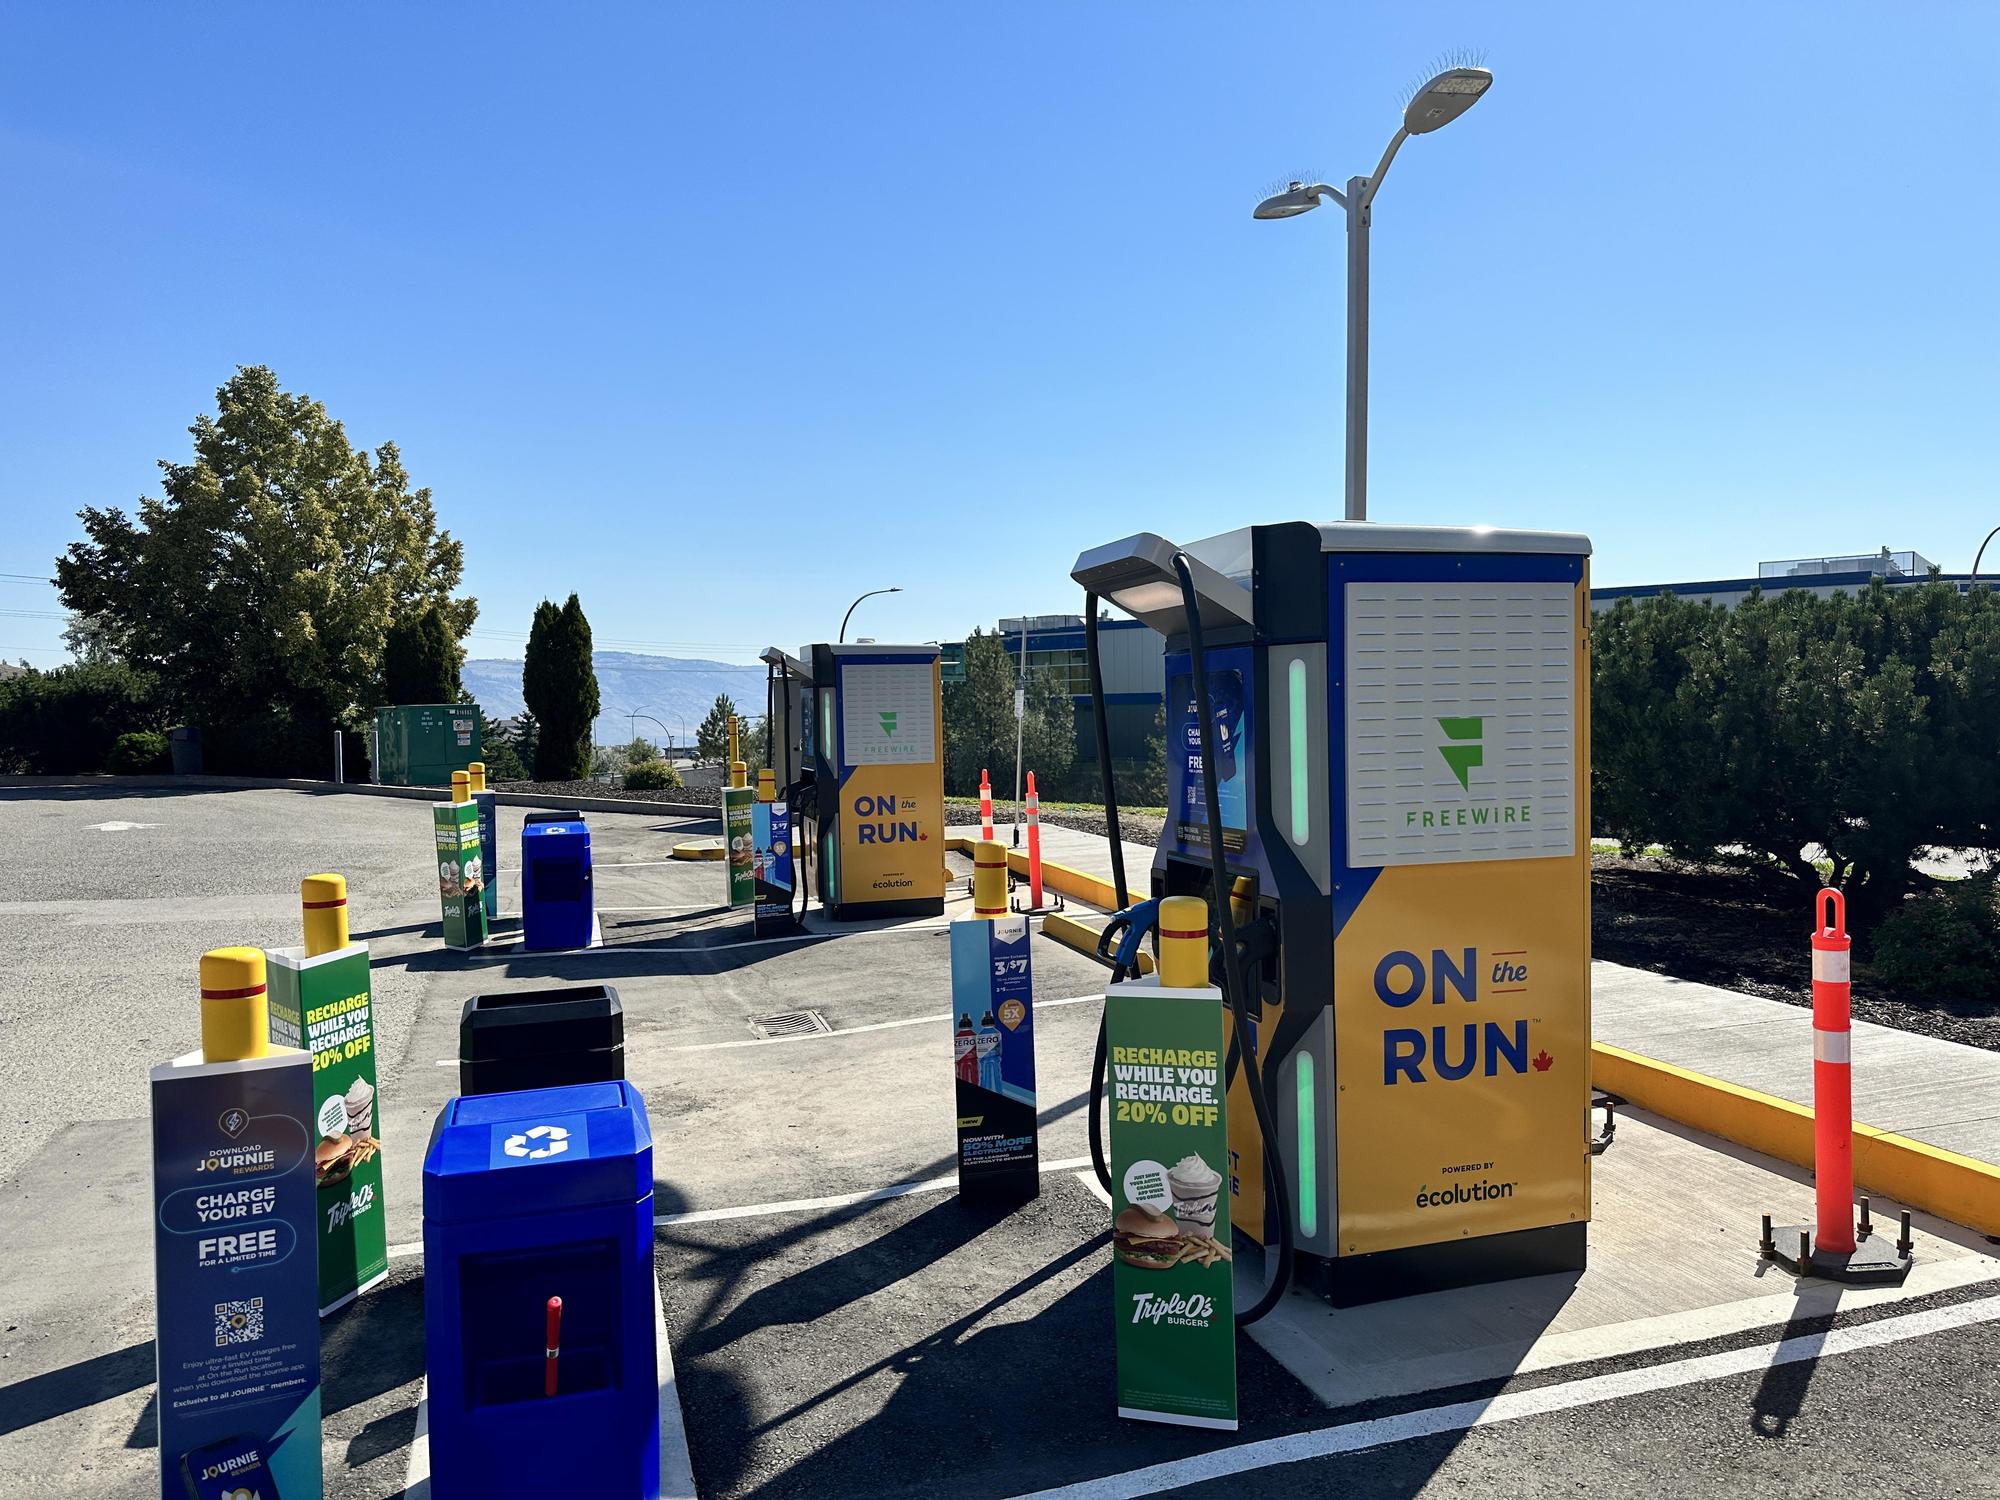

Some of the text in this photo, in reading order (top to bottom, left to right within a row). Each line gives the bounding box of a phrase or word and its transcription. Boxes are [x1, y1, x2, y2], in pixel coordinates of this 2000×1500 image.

[1189, 756, 1203, 770] FRE
[854, 795, 916, 817] ON the
[1406, 805, 1532, 828] FREEWIRE
[994, 959, 1027, 976] 3/$7
[1373, 947, 1528, 1008] ON the
[306, 992, 368, 1024] RECHARGE
[1004, 1008, 1020, 1019] 5X
[308, 1006, 369, 1039] WHILE YOU
[309, 1022, 370, 1053] RECHARGE.
[313, 1035, 370, 1072] 20% OFF
[1113, 1046, 1217, 1068] RECHARGE
[1114, 1065, 1217, 1086] WHILE YOU
[1115, 1083, 1219, 1105] RECHARGE.
[1117, 1101, 1219, 1127] 20% OFF
[210, 1145, 261, 1157] DOWNLOAD
[964, 1136, 1032, 1150] 50% MORE
[197, 1150, 274, 1172] JOURNIE
[234, 1163, 274, 1175] REWARDS
[1442, 1162, 1494, 1174] POWERED BY
[196, 1187, 276, 1209] CHARGE
[198, 1201, 275, 1222] YOUR EV
[199, 1229, 276, 1260] FREE
[200, 1259, 216, 1267] FOR
[226, 1252, 256, 1263] LIMITED
[258, 1250, 276, 1258] TIME
[1168, 1317, 1209, 1328] BURGERS
[183, 1361, 204, 1370] Enjoy
[205, 1354, 238, 1365] ultra-fast
[252, 1347, 280, 1358] charges
[282, 1343, 296, 1351] free
[228, 1359, 253, 1368] limited
[173, 1384, 194, 1393] when
[196, 1382, 210, 1390] you
[211, 1375, 248, 1386] download
[262, 1367, 289, 1377] Journie
[208, 1372, 218, 1380] On
[220, 1370, 232, 1378] the
[234, 1367, 249, 1375] Run
[250, 1361, 282, 1372] locations
[174, 1395, 208, 1408] Exclusive
[270, 1378, 307, 1389] members.
[202, 1451, 259, 1480] JOURNIE
[231, 1462, 262, 1477] REWARDS
